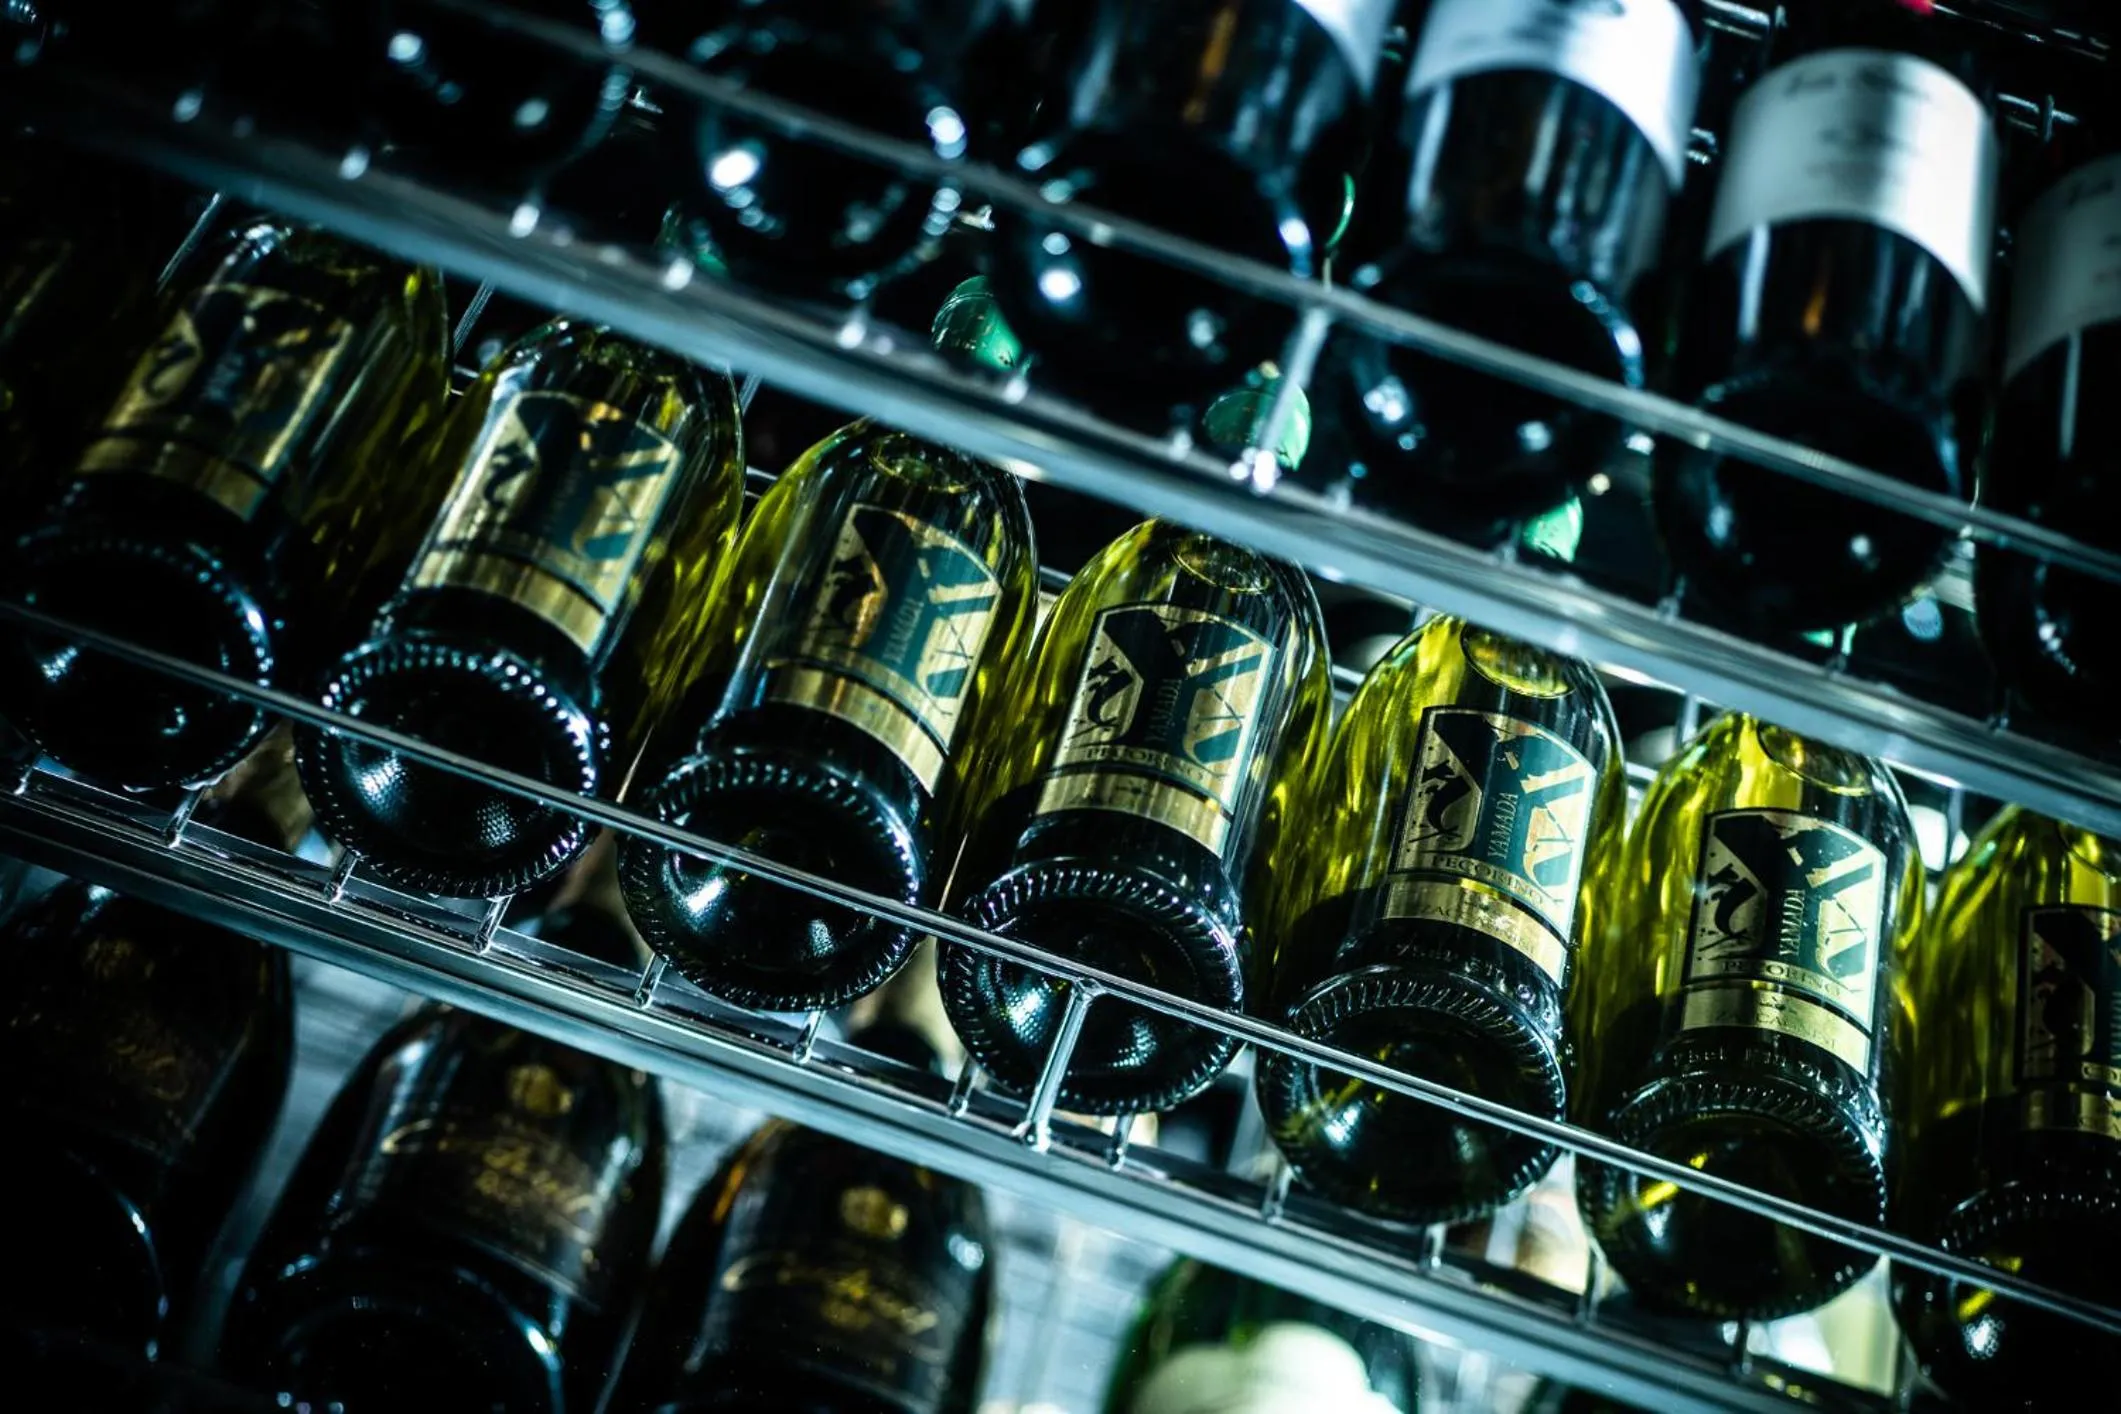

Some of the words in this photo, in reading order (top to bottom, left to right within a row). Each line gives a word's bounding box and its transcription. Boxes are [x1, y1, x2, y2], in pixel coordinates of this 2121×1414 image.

[1488, 791, 1519, 860] YAMADA
[1432, 855, 1544, 905] PECORINO
[1778, 888, 1807, 956] YAMADA
[1722, 961, 1841, 997] PEORINO
